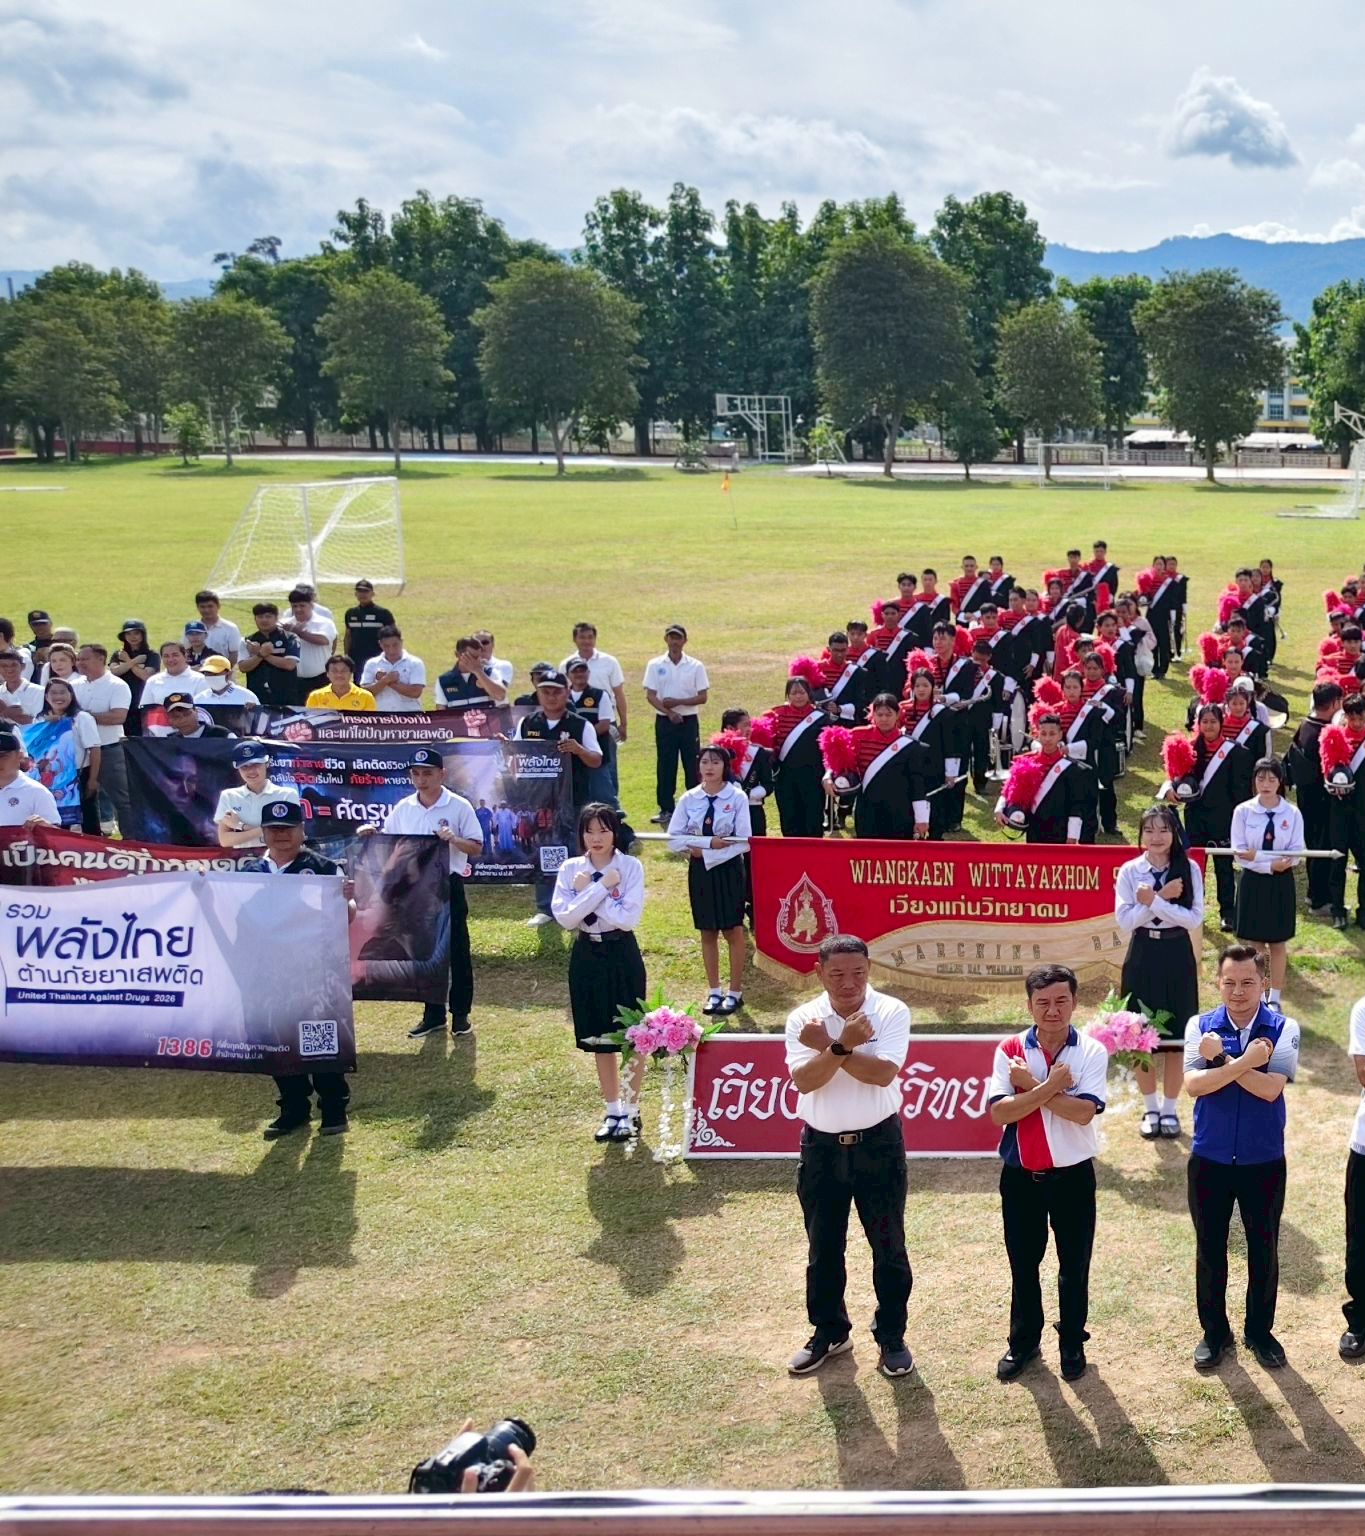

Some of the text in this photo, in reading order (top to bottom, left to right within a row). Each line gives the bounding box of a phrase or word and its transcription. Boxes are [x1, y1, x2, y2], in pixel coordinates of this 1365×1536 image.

[318, 726, 453, 740] และแก้ไขปัญหายาเสพติด
[519, 755, 561, 767] พลังไทย
[350, 773, 414, 785] ภัยร้ายหายจา
[850, 859, 955, 887] WIANGKAEN
[968, 862, 1100, 890] WITTAYAKHOM
[6, 903, 51, 919] รวม
[890, 894, 1069, 918] เวียงแก่นวิทยาคม
[16, 912, 194, 960] พลังไทย
[892, 943, 1041, 967] MARCHING
[18, 963, 203, 985] ต้านภัยยาเสพติด
[18, 991, 176, 1003] United Thailand Against Drugs 2026
[157, 1036, 213, 1058] 1386
